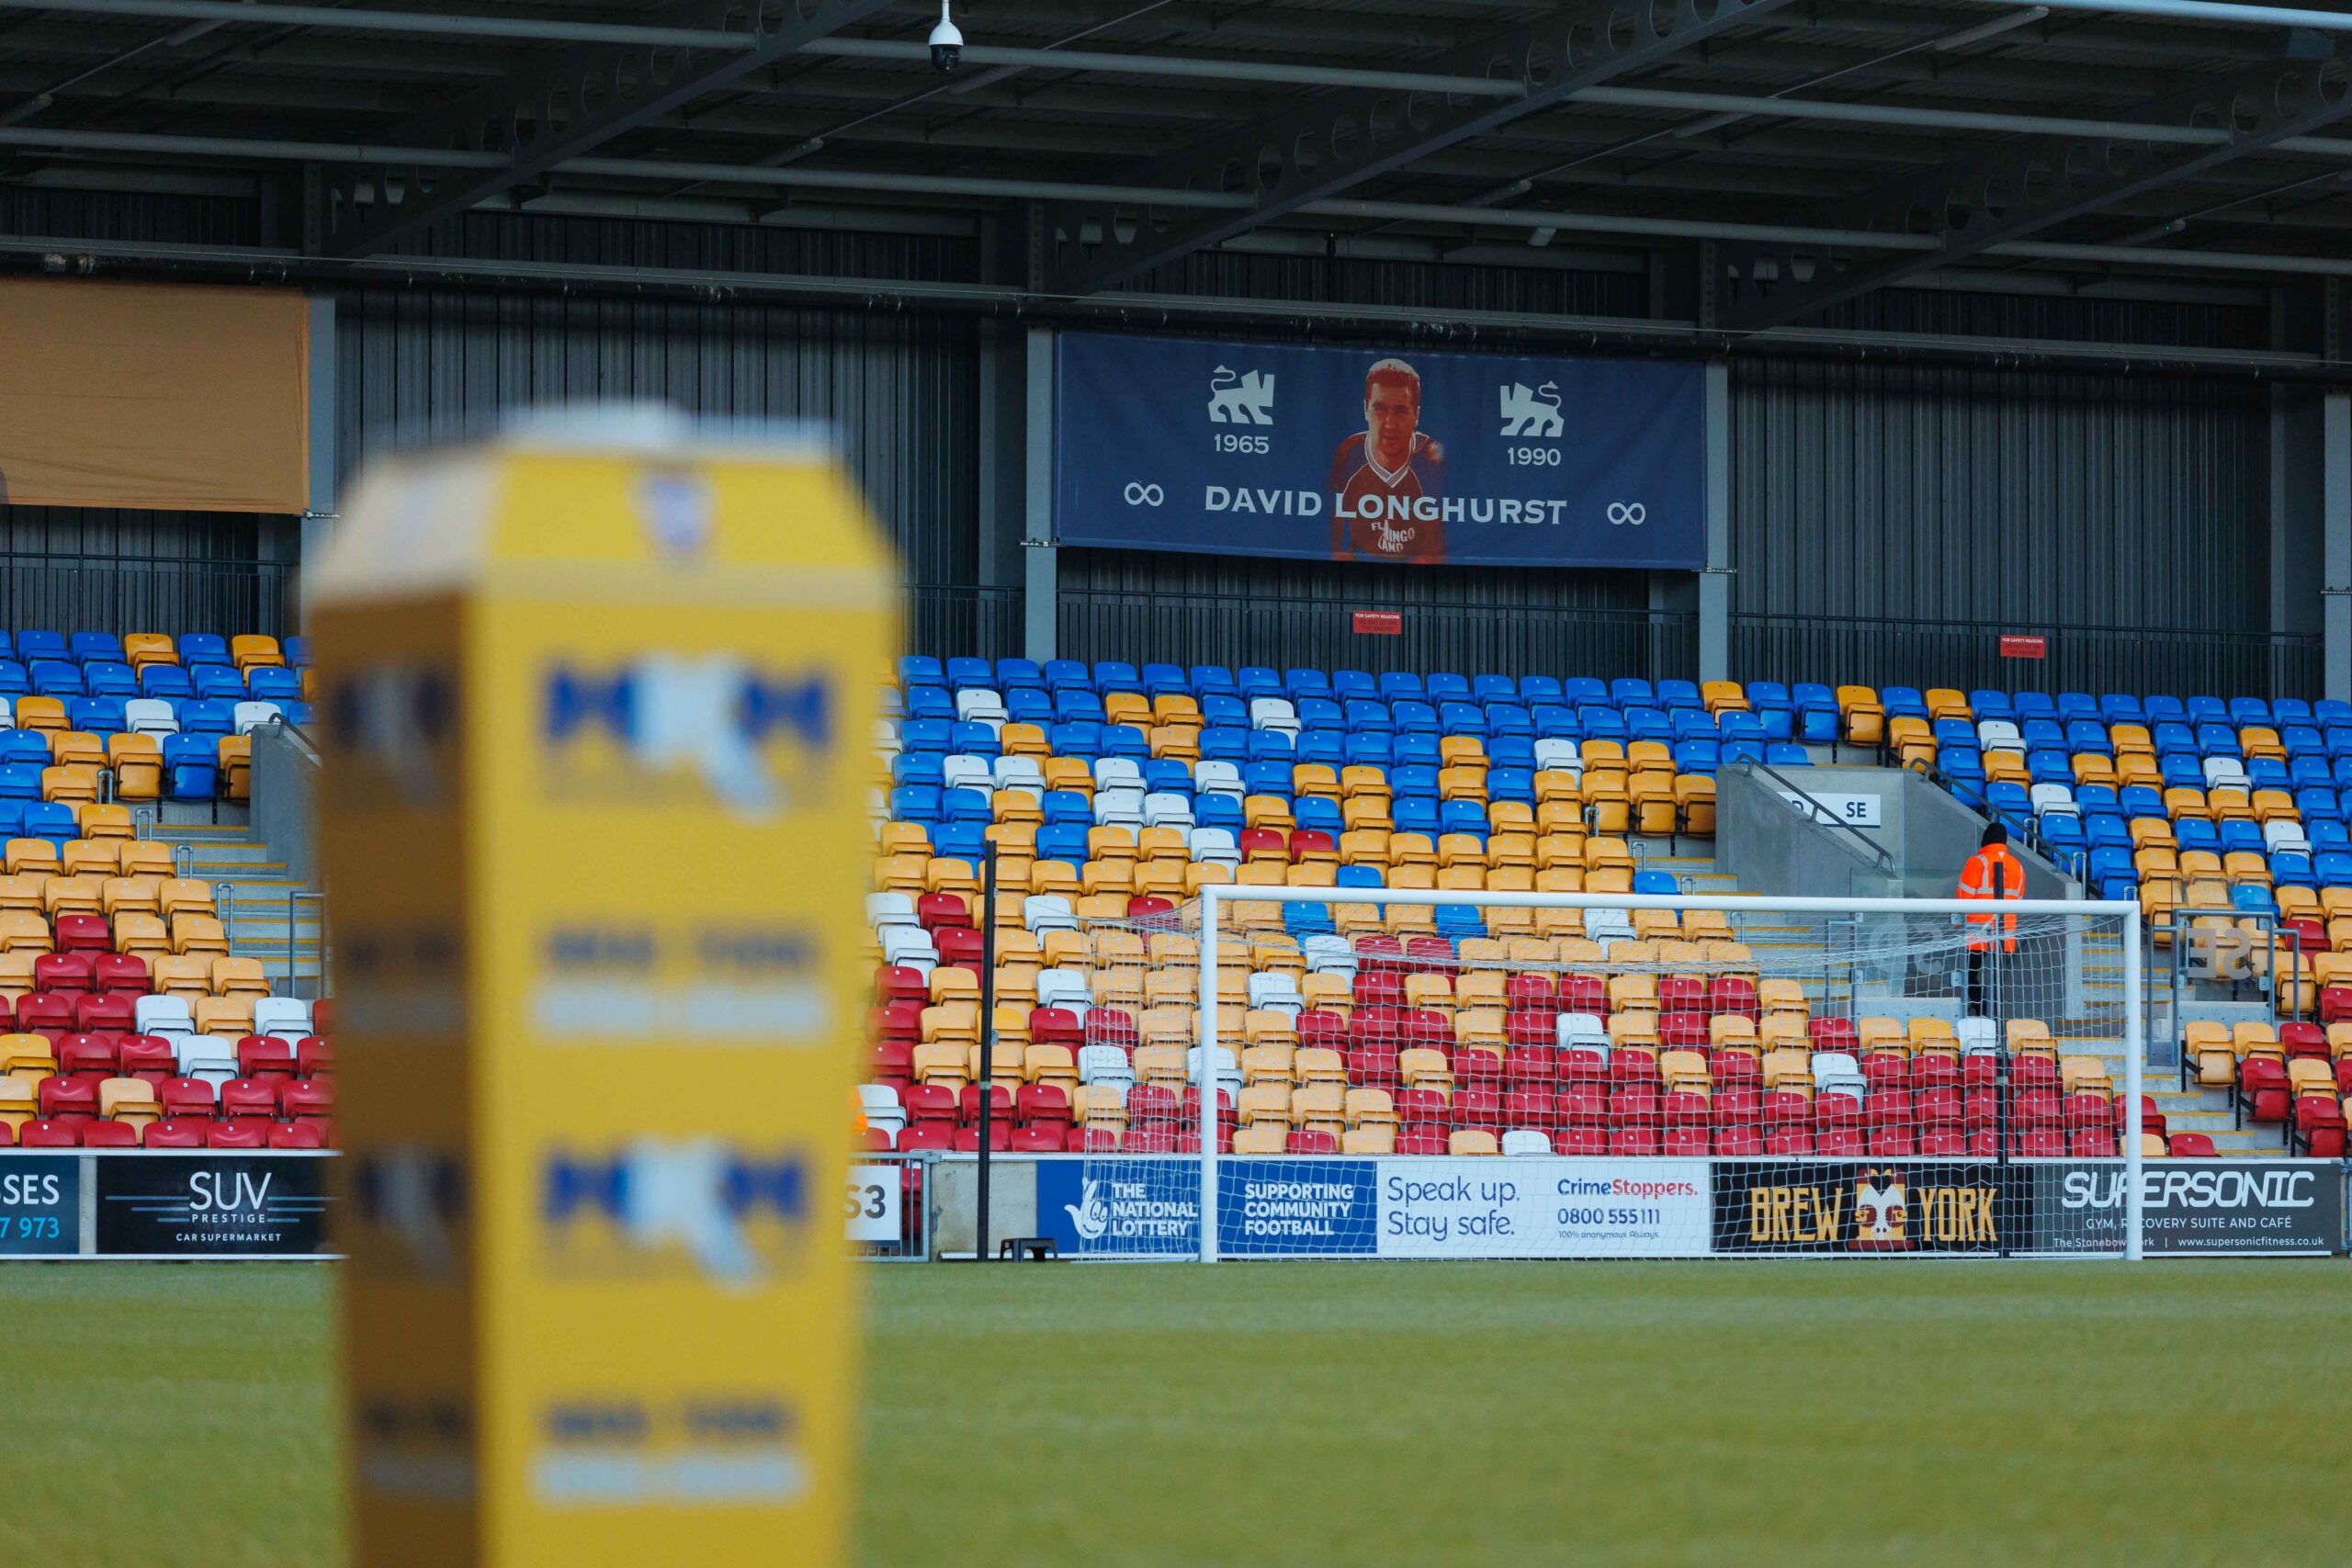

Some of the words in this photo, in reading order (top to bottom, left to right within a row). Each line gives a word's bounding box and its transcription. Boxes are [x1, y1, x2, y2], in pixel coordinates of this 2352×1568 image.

[1215, 434, 1270, 455] 1965
[1507, 446, 1562, 467] 1990
[1204, 485, 1322, 516] DAVID
[1335, 492, 1567, 525] LONGHURST
[1846, 801, 1867, 818] SE
[189, 1171, 272, 1211] SUV
[1112, 1183, 1146, 1199] THE
[1245, 1183, 1353, 1200] SUPPORTING
[1387, 1176, 1472, 1208] Speak
[1481, 1182, 1521, 1208] up.
[842, 1184, 886, 1220] S3
[1112, 1201, 1198, 1217] NATIONAL
[1245, 1201, 1351, 1217] COMMUNITY
[192, 1213, 266, 1224] PRESTIGE
[1557, 1208, 1604, 1224] 0800
[1750, 1188, 1843, 1241] BREW
[1917, 1188, 1998, 1241] YORK
[2086, 1218, 2117, 1230] GYM,
[2190, 1217, 2225, 1228] SUITE
[2229, 1217, 2256, 1228] AND
[2260, 1215, 2292, 1228] CAFÉ
[18, 1216, 60, 1239] 973
[1112, 1220, 1188, 1236] LOTTERY
[1245, 1220, 1335, 1235] FOOTBALL
[1387, 1211, 1448, 1241] Stay
[1457, 1210, 1515, 1235] safe.
[175, 1233, 198, 1242] CAR
[200, 1233, 281, 1242] SUPERMARKET
[1559, 1230, 1579, 1239] 100%
[2053, 1237, 2073, 1247] The
[2178, 1236, 2324, 1247] www.supersonicfitness.co.uk
